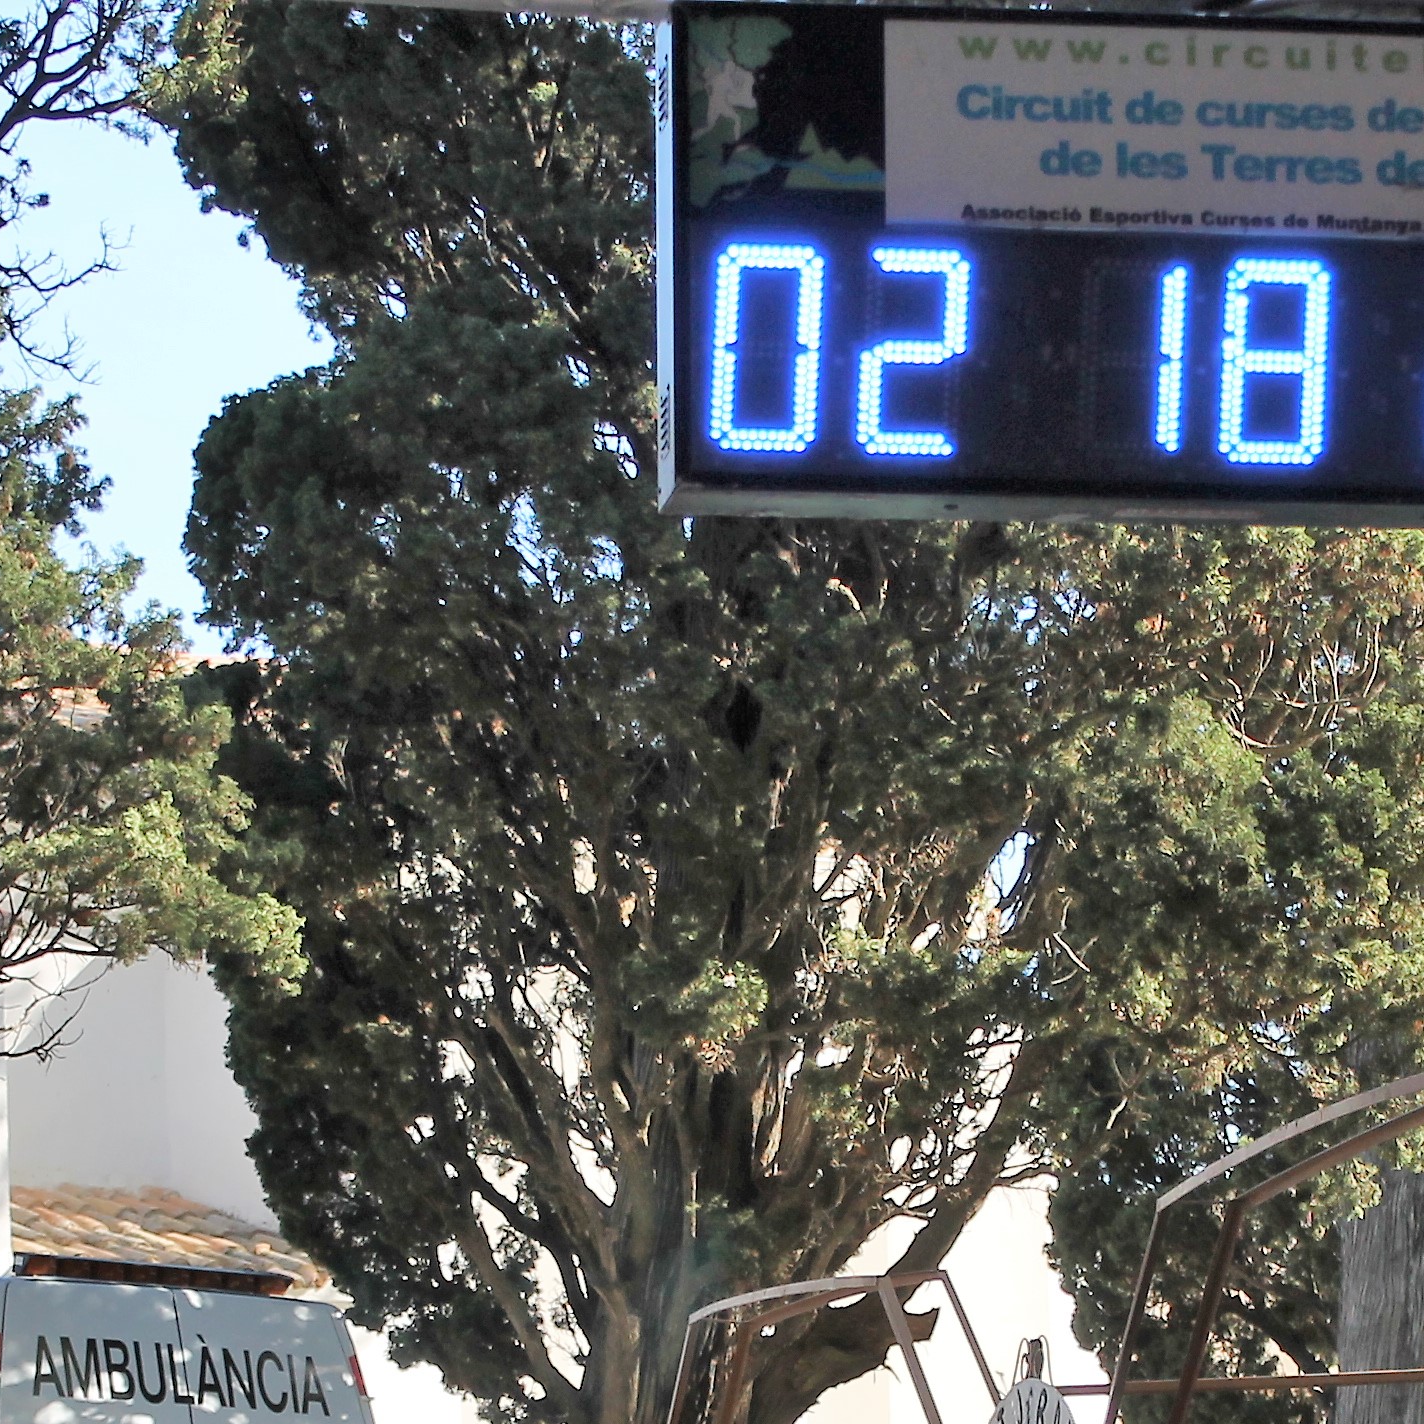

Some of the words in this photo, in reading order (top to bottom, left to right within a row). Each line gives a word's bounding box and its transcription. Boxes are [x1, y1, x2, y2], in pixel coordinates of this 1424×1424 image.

[956, 84, 1113, 125] Circuit
[1125, 90, 1183, 125] de
[1196, 100, 1355, 132] curses
[1367, 98, 1424, 133] de
[1040, 140, 1102, 178] de
[1116, 141, 1188, 179] les
[1200, 143, 1363, 186] Terres
[960, 203, 1082, 222] Associació
[1089, 206, 1193, 226] Esportiva
[1200, 210, 1276, 227] Curses
[1282, 213, 1308, 229] de
[1316, 214, 1422, 235] Muntanya
[708, 242, 971, 455] 02
[1154, 256, 1331, 466] 18
[32, 1333, 331, 1417] AMBULÀNCIA
